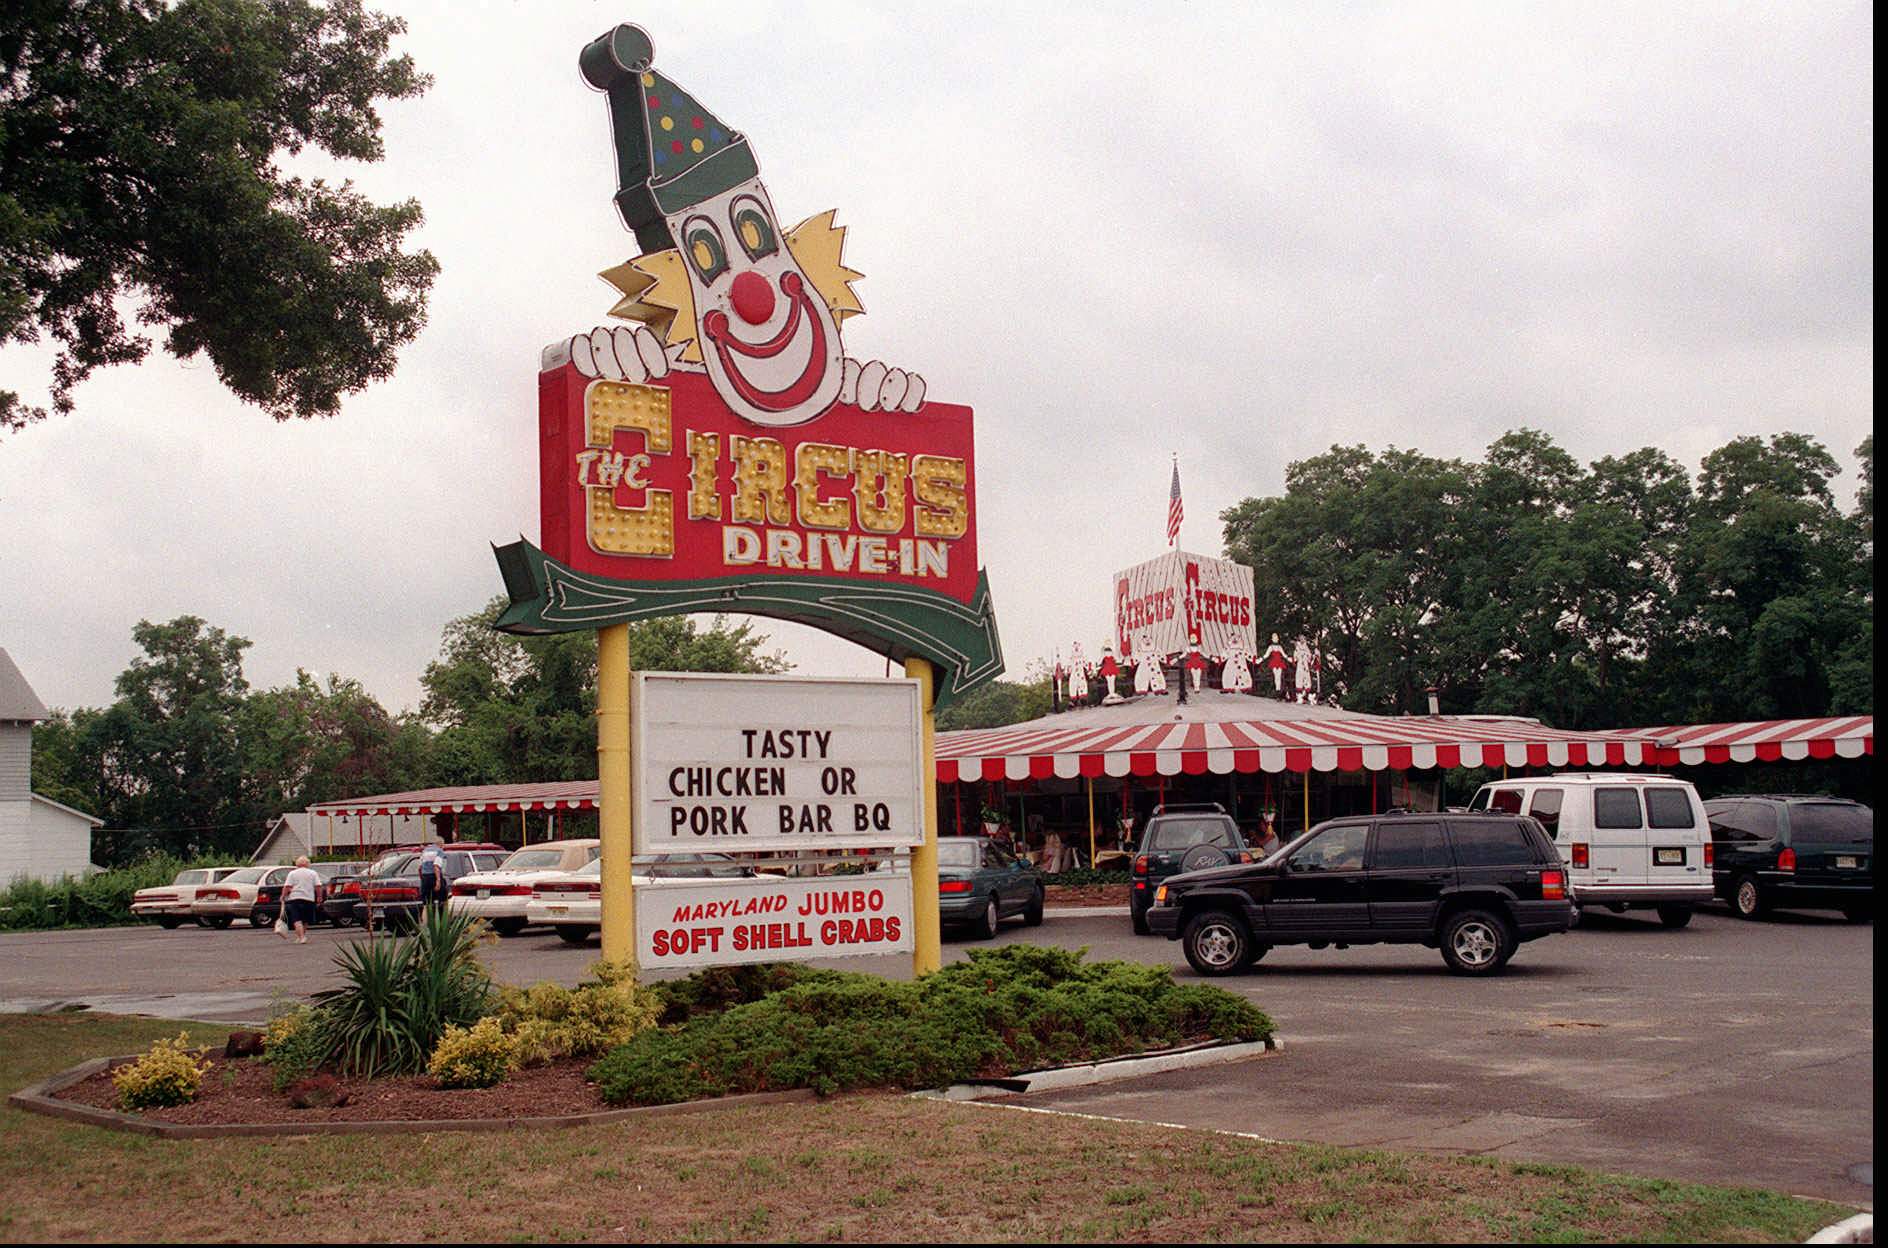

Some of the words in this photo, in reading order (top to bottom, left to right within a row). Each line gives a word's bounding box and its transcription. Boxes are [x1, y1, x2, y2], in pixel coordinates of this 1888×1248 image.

[576, 449, 652, 489] THE
[584, 379, 967, 559] CIRCUS
[722, 525, 949, 578] DRIVE-IN
[1116, 577, 1175, 657] CIRCUS
[1185, 562, 1250, 645] CIRCUS
[742, 730, 832, 758] TASTY
[669, 767, 786, 797] CHICKEN
[822, 767, 856, 795] OR
[671, 806, 749, 836] PORK
[779, 804, 833, 833] BAR
[854, 803, 891, 832] BQ
[672, 894, 788, 923] MARYLAND
[798, 889, 884, 916] JUMBO
[652, 927, 724, 957] SOFT
[732, 922, 813, 951] SHELL
[821, 916, 901, 945] CRABS
